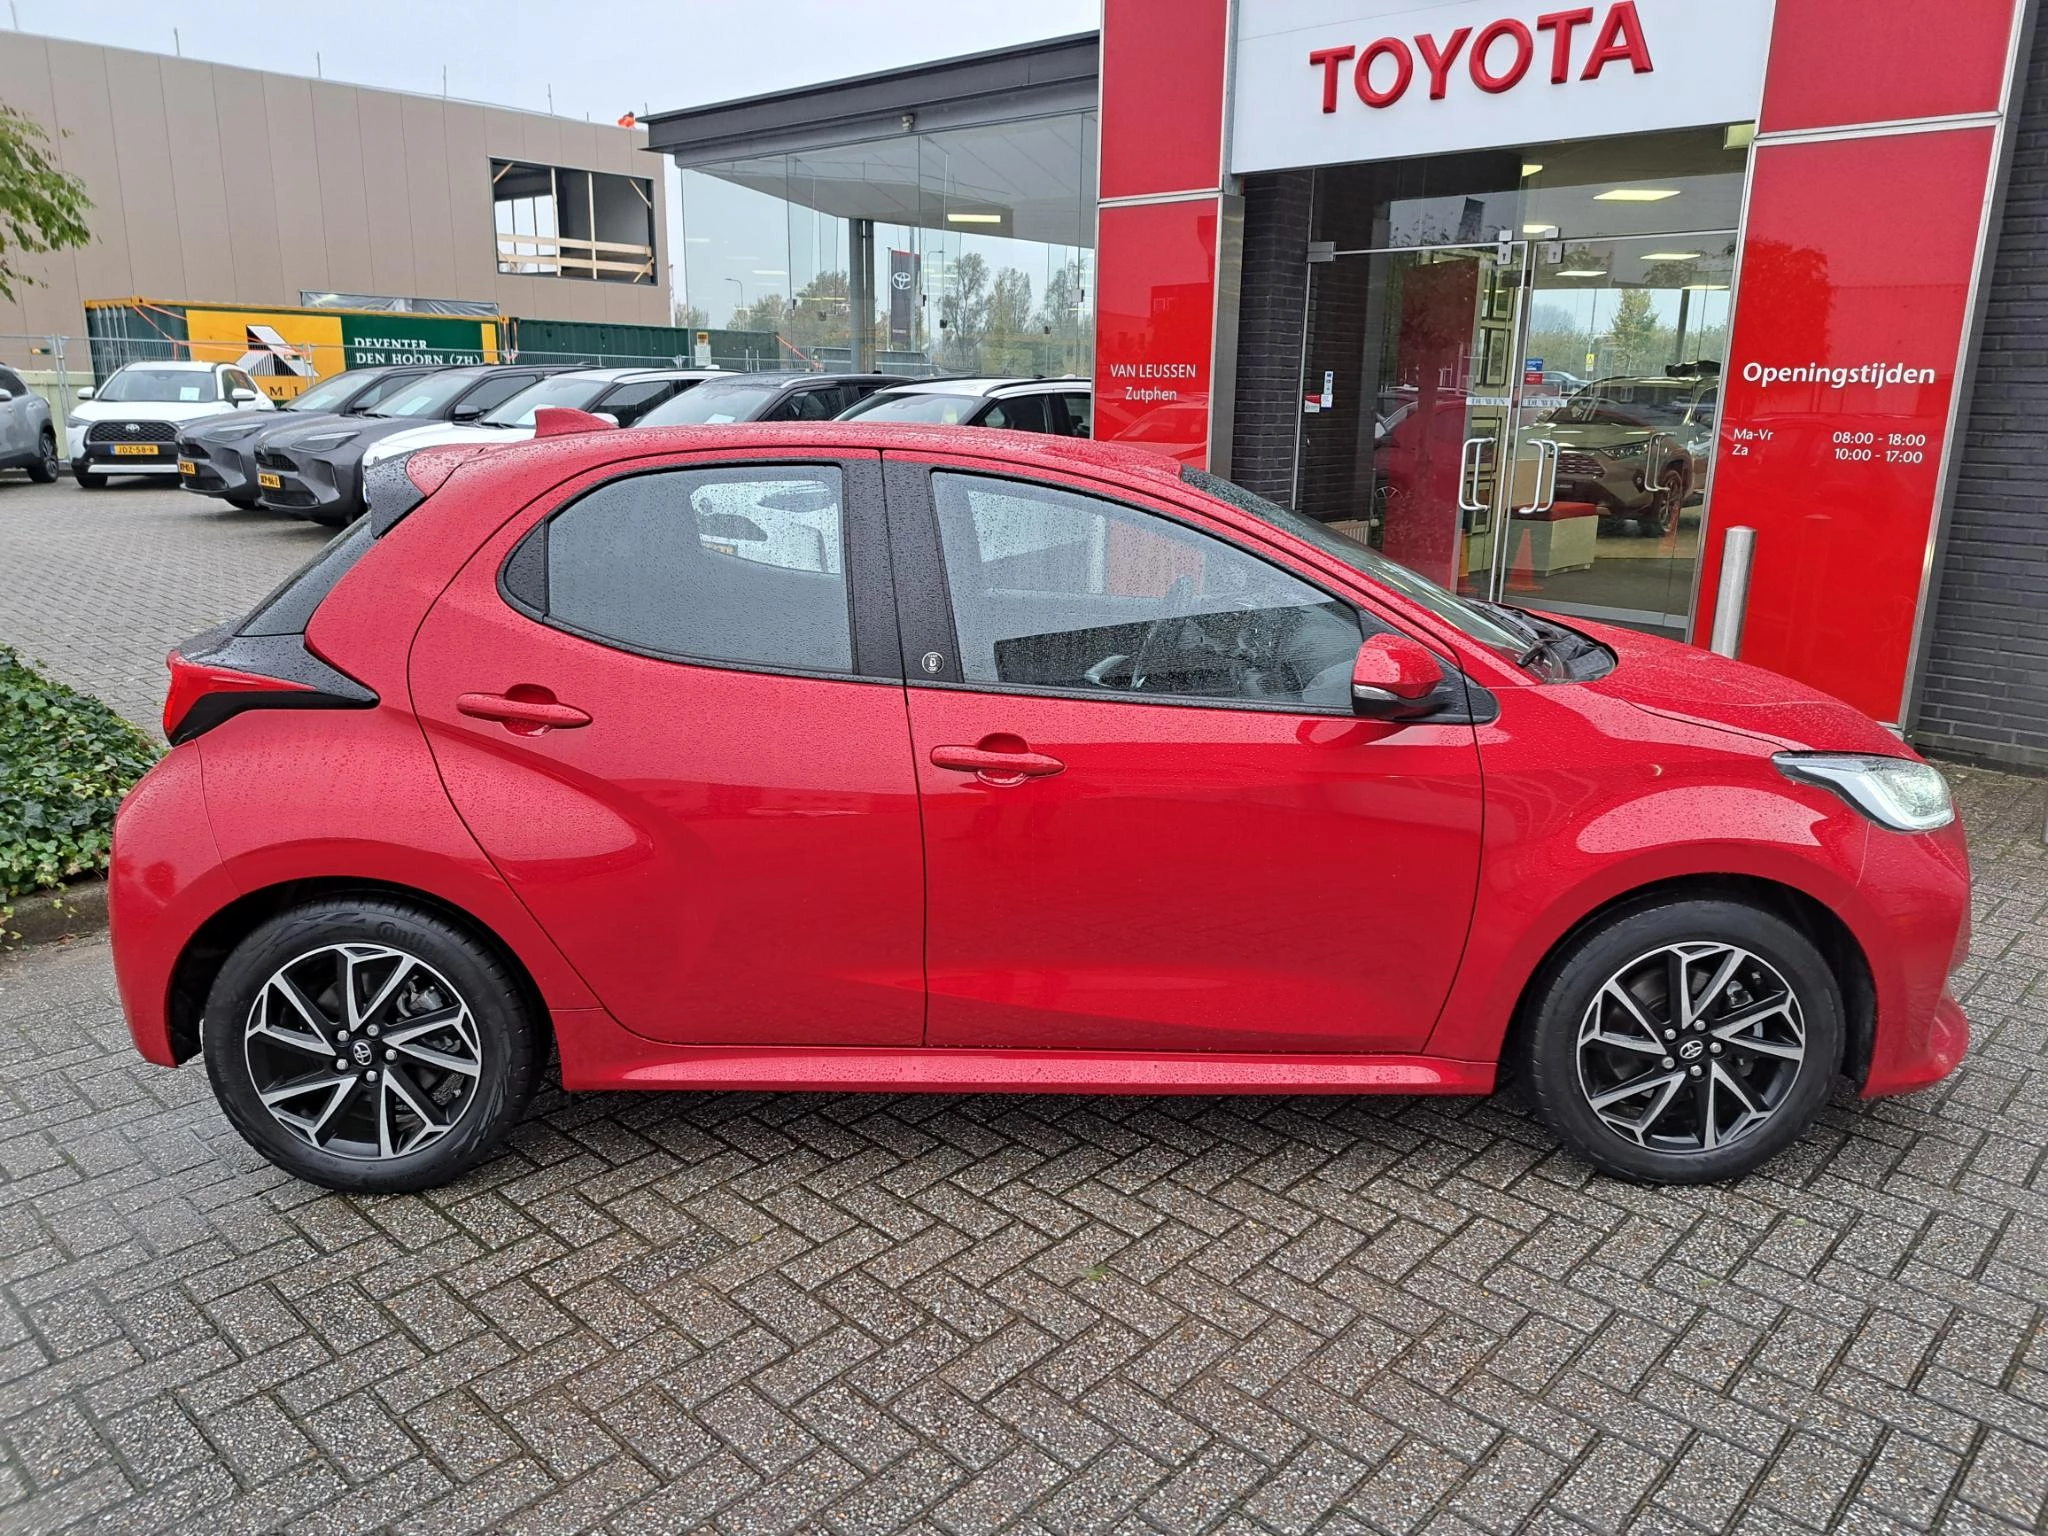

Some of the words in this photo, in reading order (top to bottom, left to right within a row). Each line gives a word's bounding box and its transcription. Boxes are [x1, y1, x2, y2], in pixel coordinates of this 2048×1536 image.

[1309, 0, 1654, 114] TOYOTA
[353, 337, 428, 350] DEVENTER
[355, 352, 386, 365] DEN
[391, 353, 444, 366] HOORN
[449, 353, 481, 366] (ZH)
[1109, 363, 1137, 378] VAN
[1139, 363, 1197, 379] LEUSSEN
[1742, 361, 1936, 390] Openingstijden
[1125, 385, 1178, 404] Zutphen
[1733, 428, 1775, 441] Ma-Vr
[1832, 431, 1874, 446] 08:00
[1888, 433, 1926, 447] 18:00
[1731, 443, 1749, 457] Za
[1834, 447, 1872, 462] 10:00
[1885, 450, 1924, 464] 17:00
